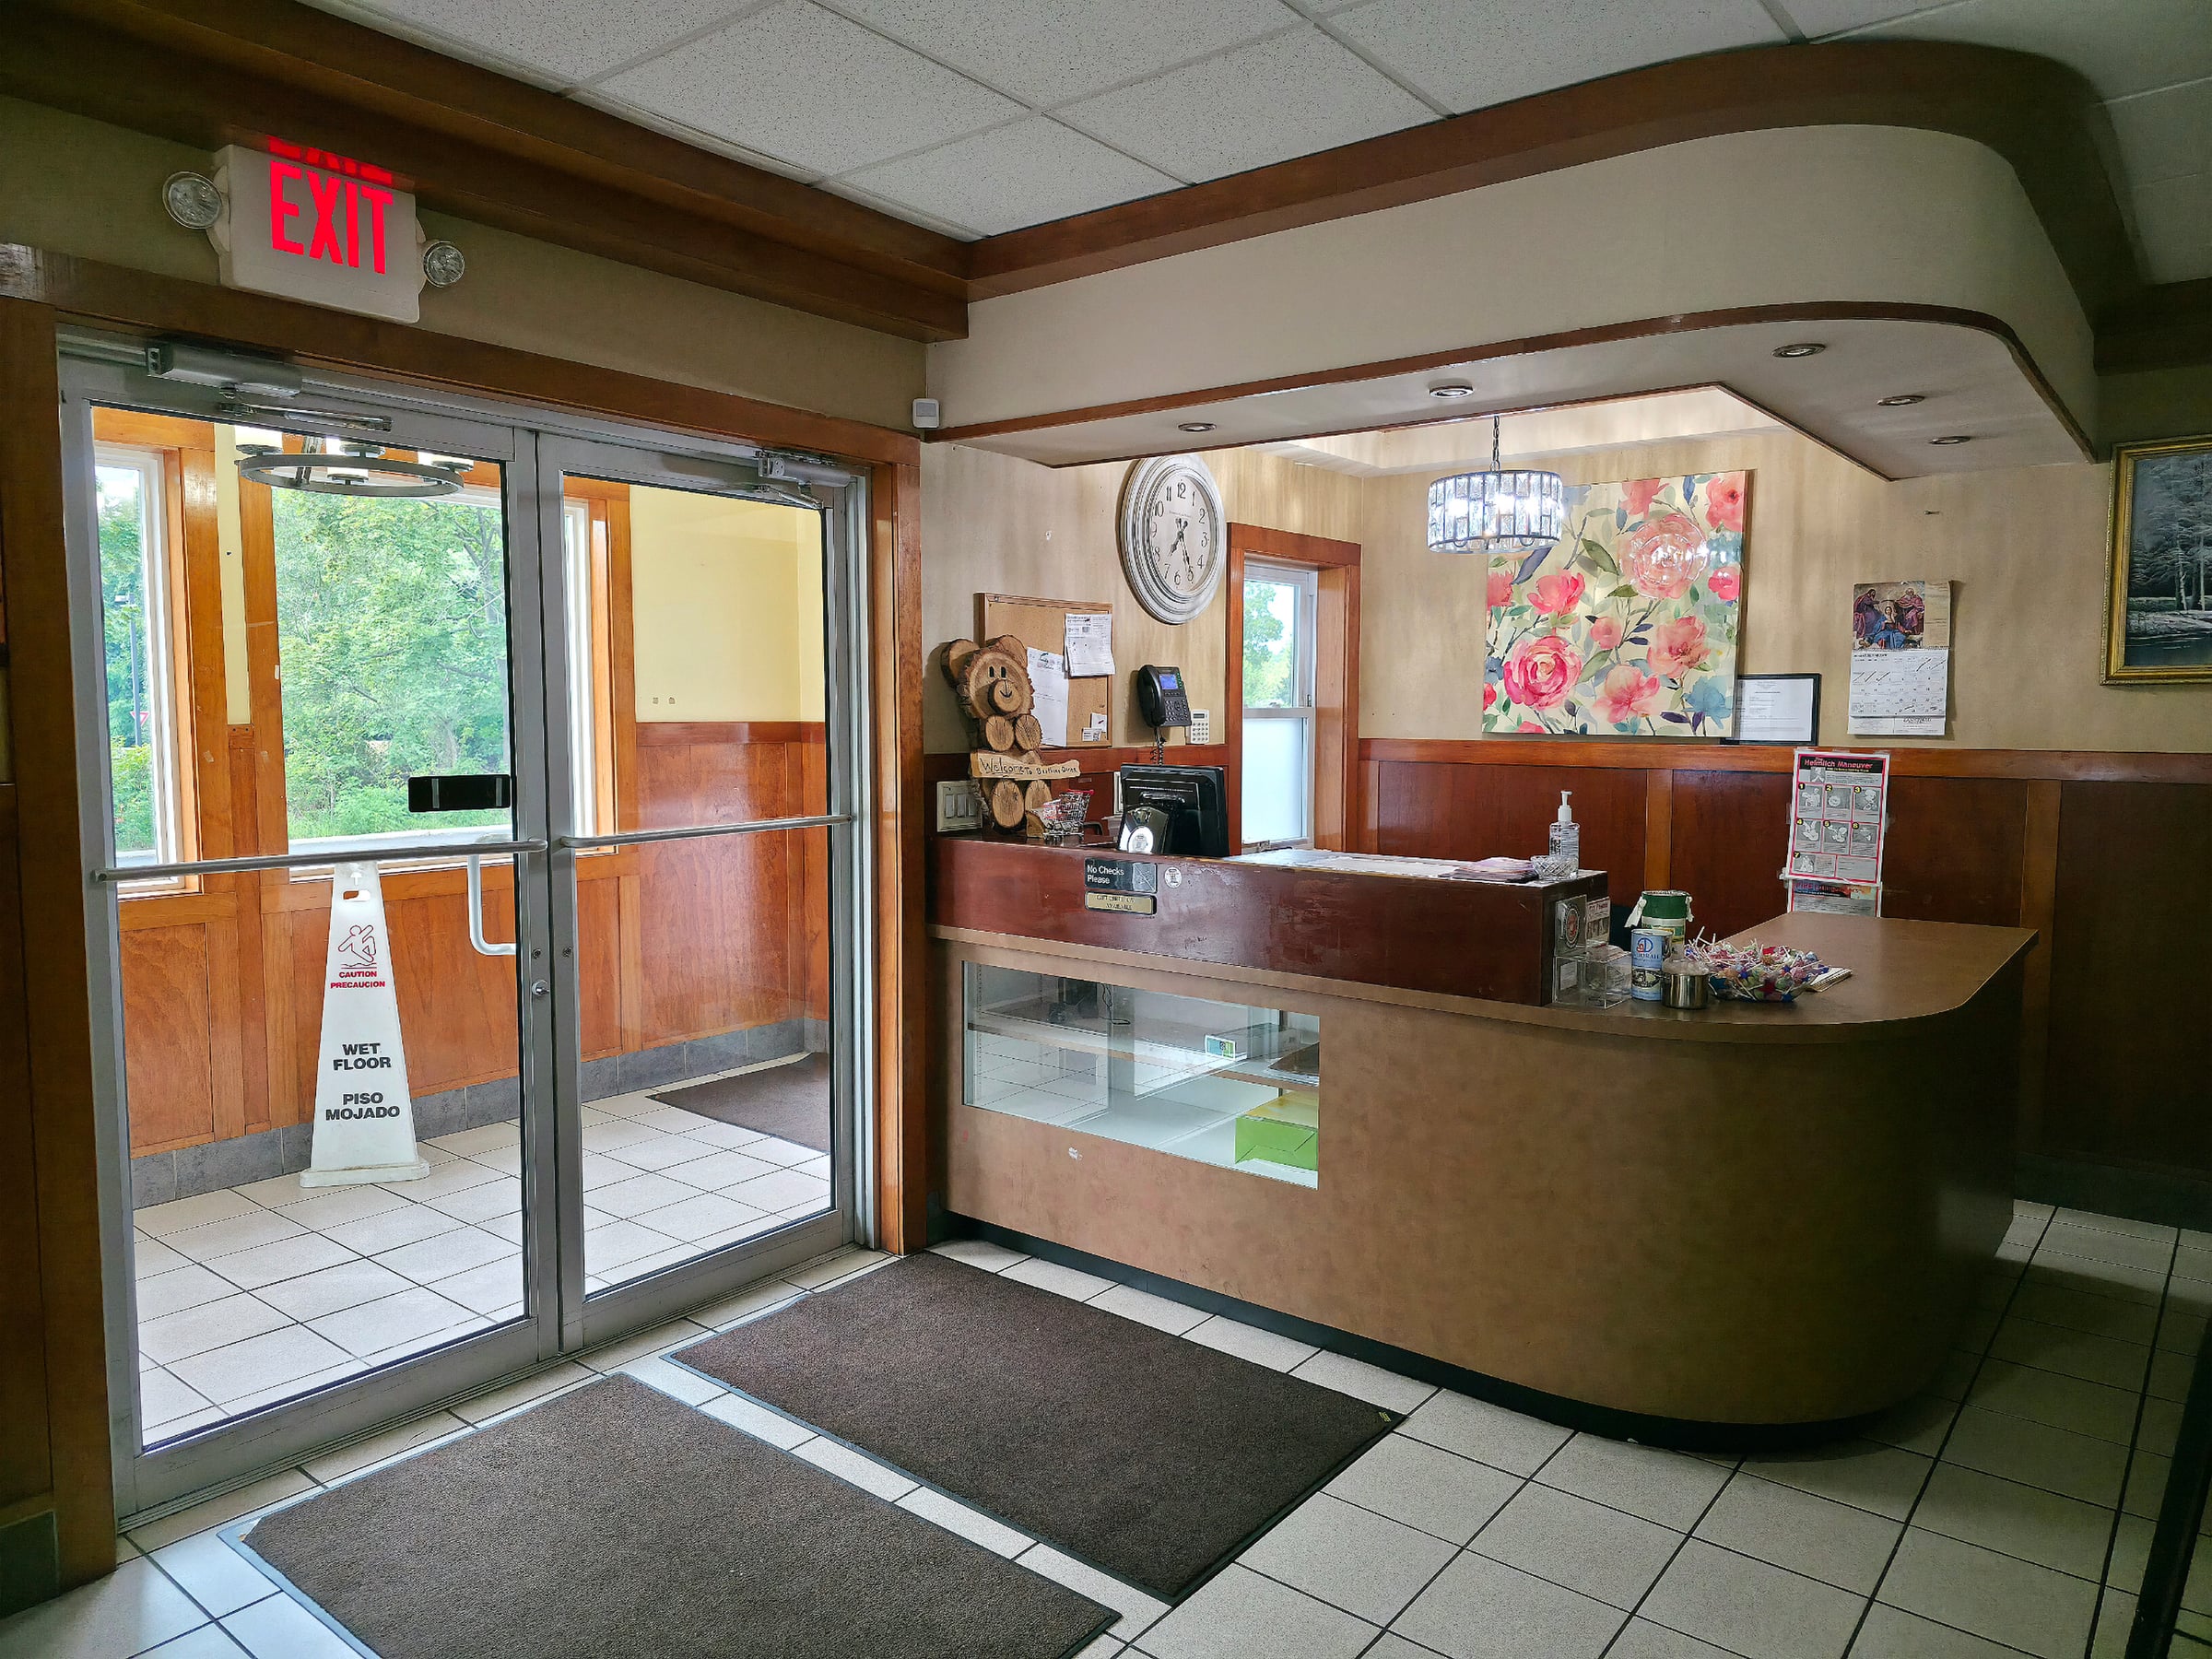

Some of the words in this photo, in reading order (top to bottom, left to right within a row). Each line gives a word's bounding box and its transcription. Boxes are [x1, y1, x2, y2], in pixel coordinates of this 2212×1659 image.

[270, 159, 394, 276] EXIT
[1166, 486, 1172, 501] 11
[1177, 482, 1186, 499] 12
[1192, 491, 1196, 507] 1
[1154, 500, 1164, 518] 10
[1199, 508, 1206, 524] 2
[1152, 522, 1158, 538] 9
[1201, 532, 1208, 547] 3
[1154, 547, 1160, 562] 8
[1198, 555, 1205, 570] 4
[1164, 563, 1171, 580] 7
[1174, 570, 1181, 585] 6
[1187, 566, 1194, 582] 5
[980, 757, 1024, 774] Welcome
[1837, 761, 1873, 770] Maneuver
[1087, 865, 1097, 874] No
[1099, 865, 1124, 876] Checks
[1087, 875, 1110, 885] Please
[338, 970, 378, 979] CAUTION
[330, 980, 385, 989] PRECAUCION
[342, 1042, 380, 1055] WET
[333, 1057, 392, 1071] FLOOR
[343, 1092, 383, 1105] PISO
[325, 1105, 400, 1121] MOJADO
